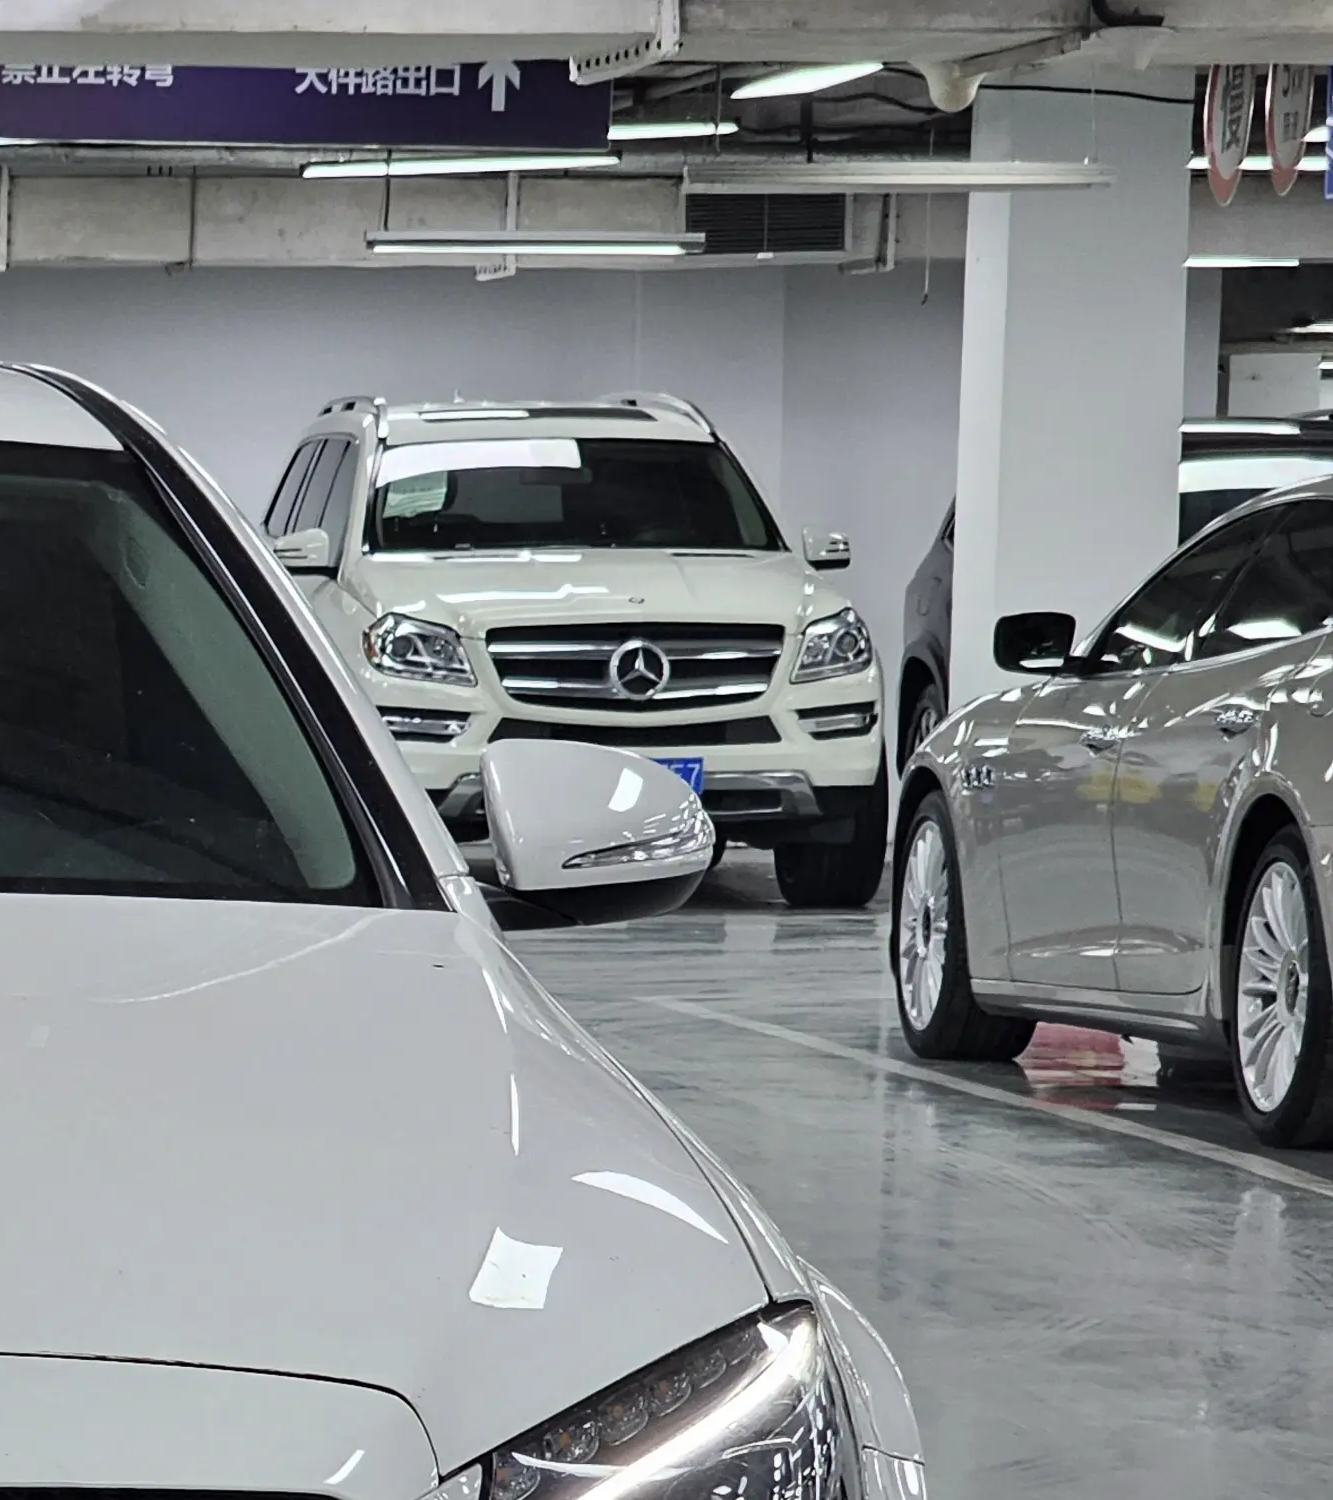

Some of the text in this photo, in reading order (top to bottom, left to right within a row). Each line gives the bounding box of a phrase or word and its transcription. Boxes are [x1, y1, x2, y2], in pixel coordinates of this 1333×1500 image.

[1, 63, 173, 87] 禁止左转弯
